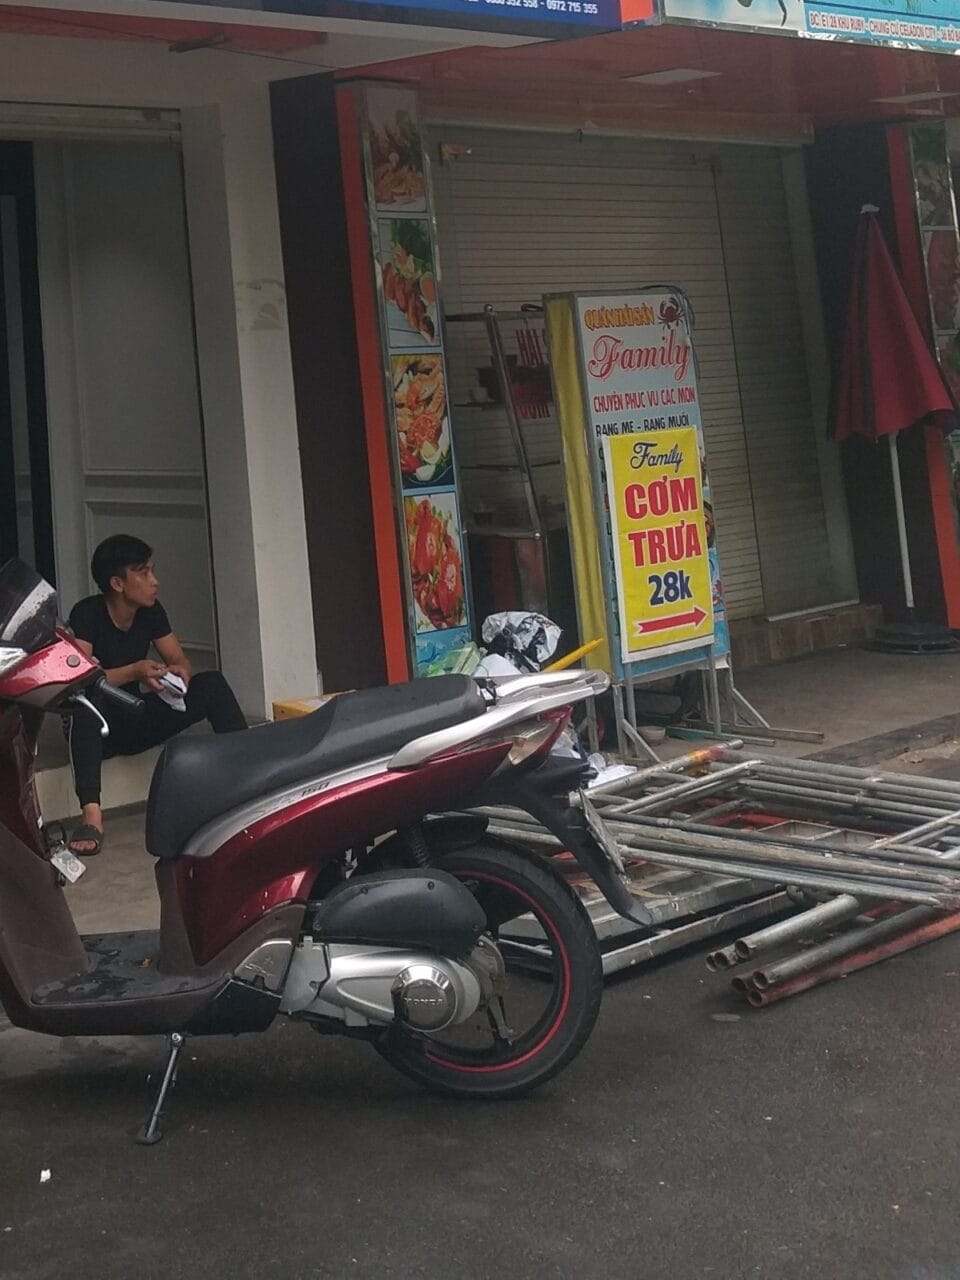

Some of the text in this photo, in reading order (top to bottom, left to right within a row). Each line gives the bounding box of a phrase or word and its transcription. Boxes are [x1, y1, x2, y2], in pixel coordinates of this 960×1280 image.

[546, 0, 566, 12] 0972
[583, 3, 598, 14] 355
[588, 329, 690, 381] Family
[630, 441, 683, 473] Family
[625, 475, 699, 521] CƠM
[628, 520, 703, 568] TRƯA
[649, 569, 693, 607] 28k
